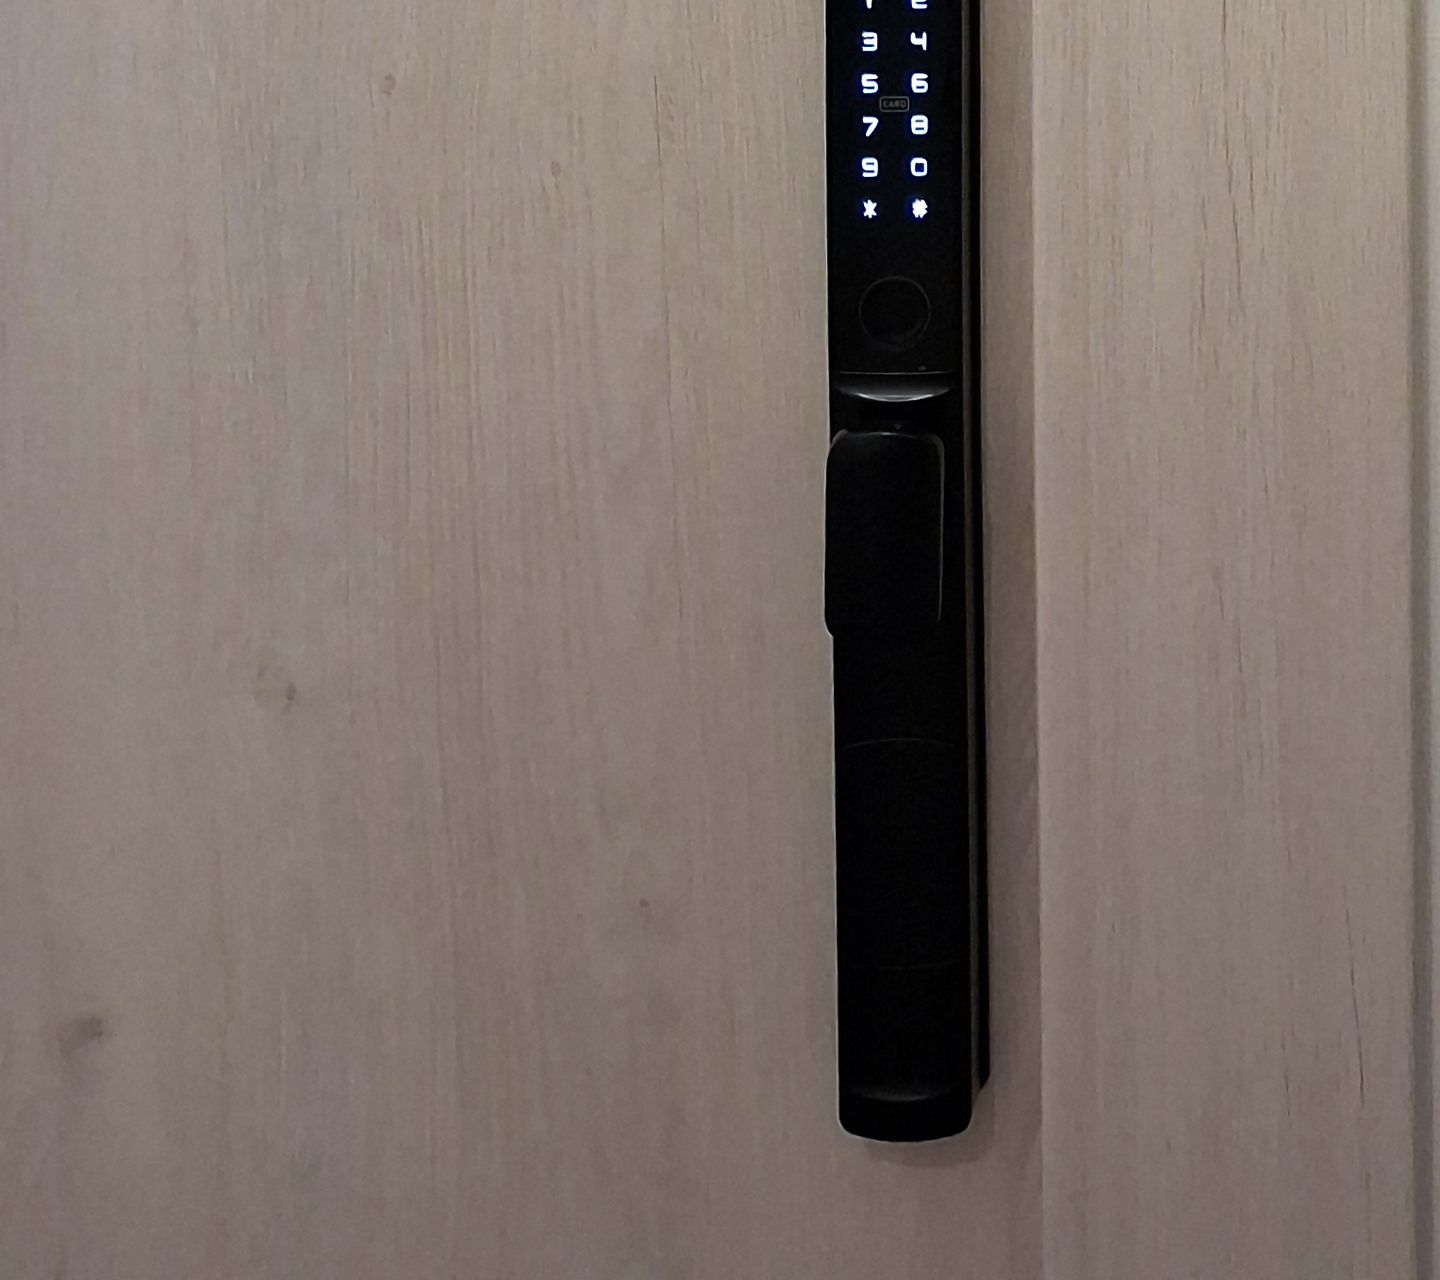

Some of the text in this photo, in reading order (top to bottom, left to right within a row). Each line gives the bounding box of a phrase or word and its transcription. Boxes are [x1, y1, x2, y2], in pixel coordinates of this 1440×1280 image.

[861, 31, 928, 52] 3 4
[861, 72, 929, 94] 5 6
[862, 114, 929, 137] 7 8
[861, 156, 928, 178] 9 0
